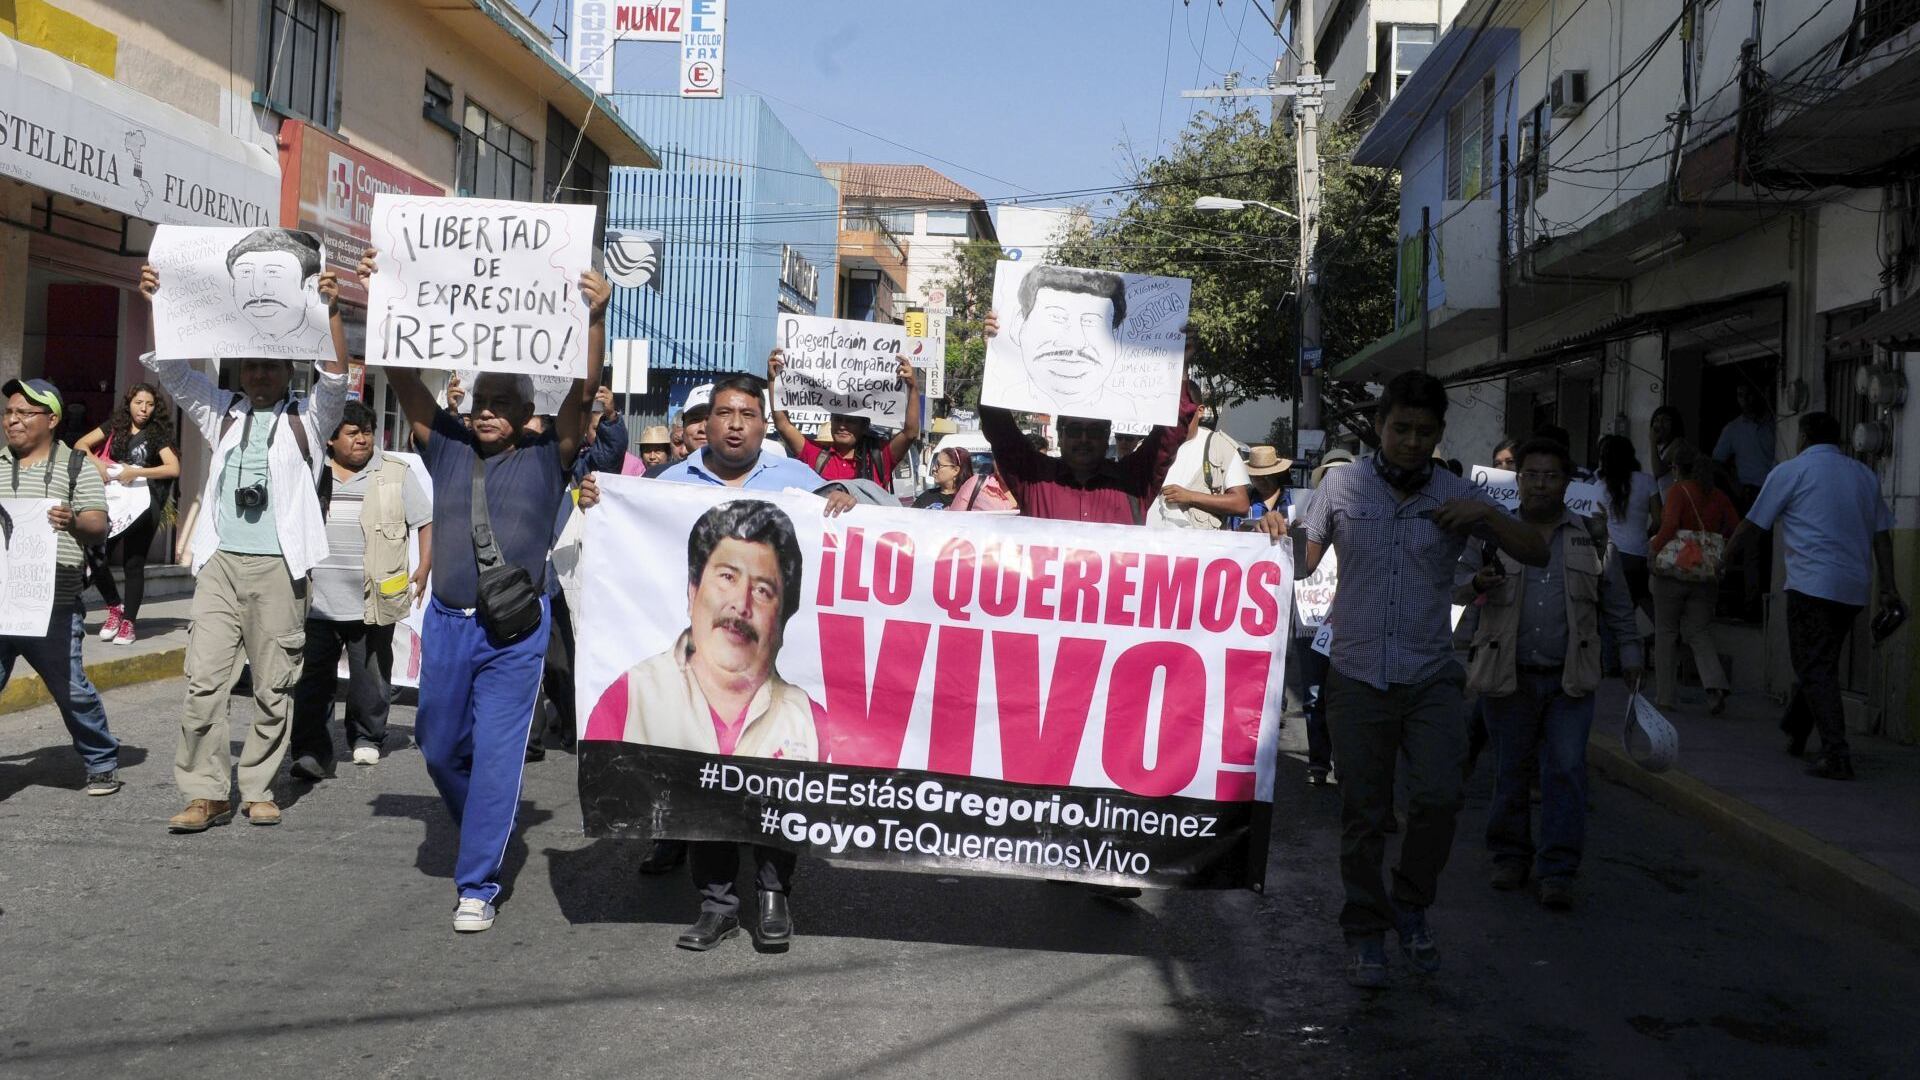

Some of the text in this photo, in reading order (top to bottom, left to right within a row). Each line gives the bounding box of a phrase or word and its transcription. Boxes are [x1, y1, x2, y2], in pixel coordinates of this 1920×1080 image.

[616, 5, 681, 32] MUÑIZ
[686, 47, 718, 59] FAX
[163, 173, 271, 228] FLORENCIA
[402, 213, 550, 261] ¡LIBERTAD
[474, 258, 500, 279] DE
[417, 280, 568, 315] EXPRESIÓN!
[1127, 292, 1185, 340] JUSTICIA
[382, 304, 573, 370] ¡RESPETO!
[785, 318, 900, 354] Presentación con
[780, 371, 832, 390] Periodista
[815, 352, 837, 370] del
[829, 395, 842, 406] de
[847, 394, 858, 408] la
[816, 527, 1282, 637] ¡LO QUEREMOS
[817, 612, 1272, 801] VIVO!
[699, 762, 1217, 839] #DondeEstásGregorioJimenez
[760, 808, 1151, 876] #GoyoTeQueremosVivo
